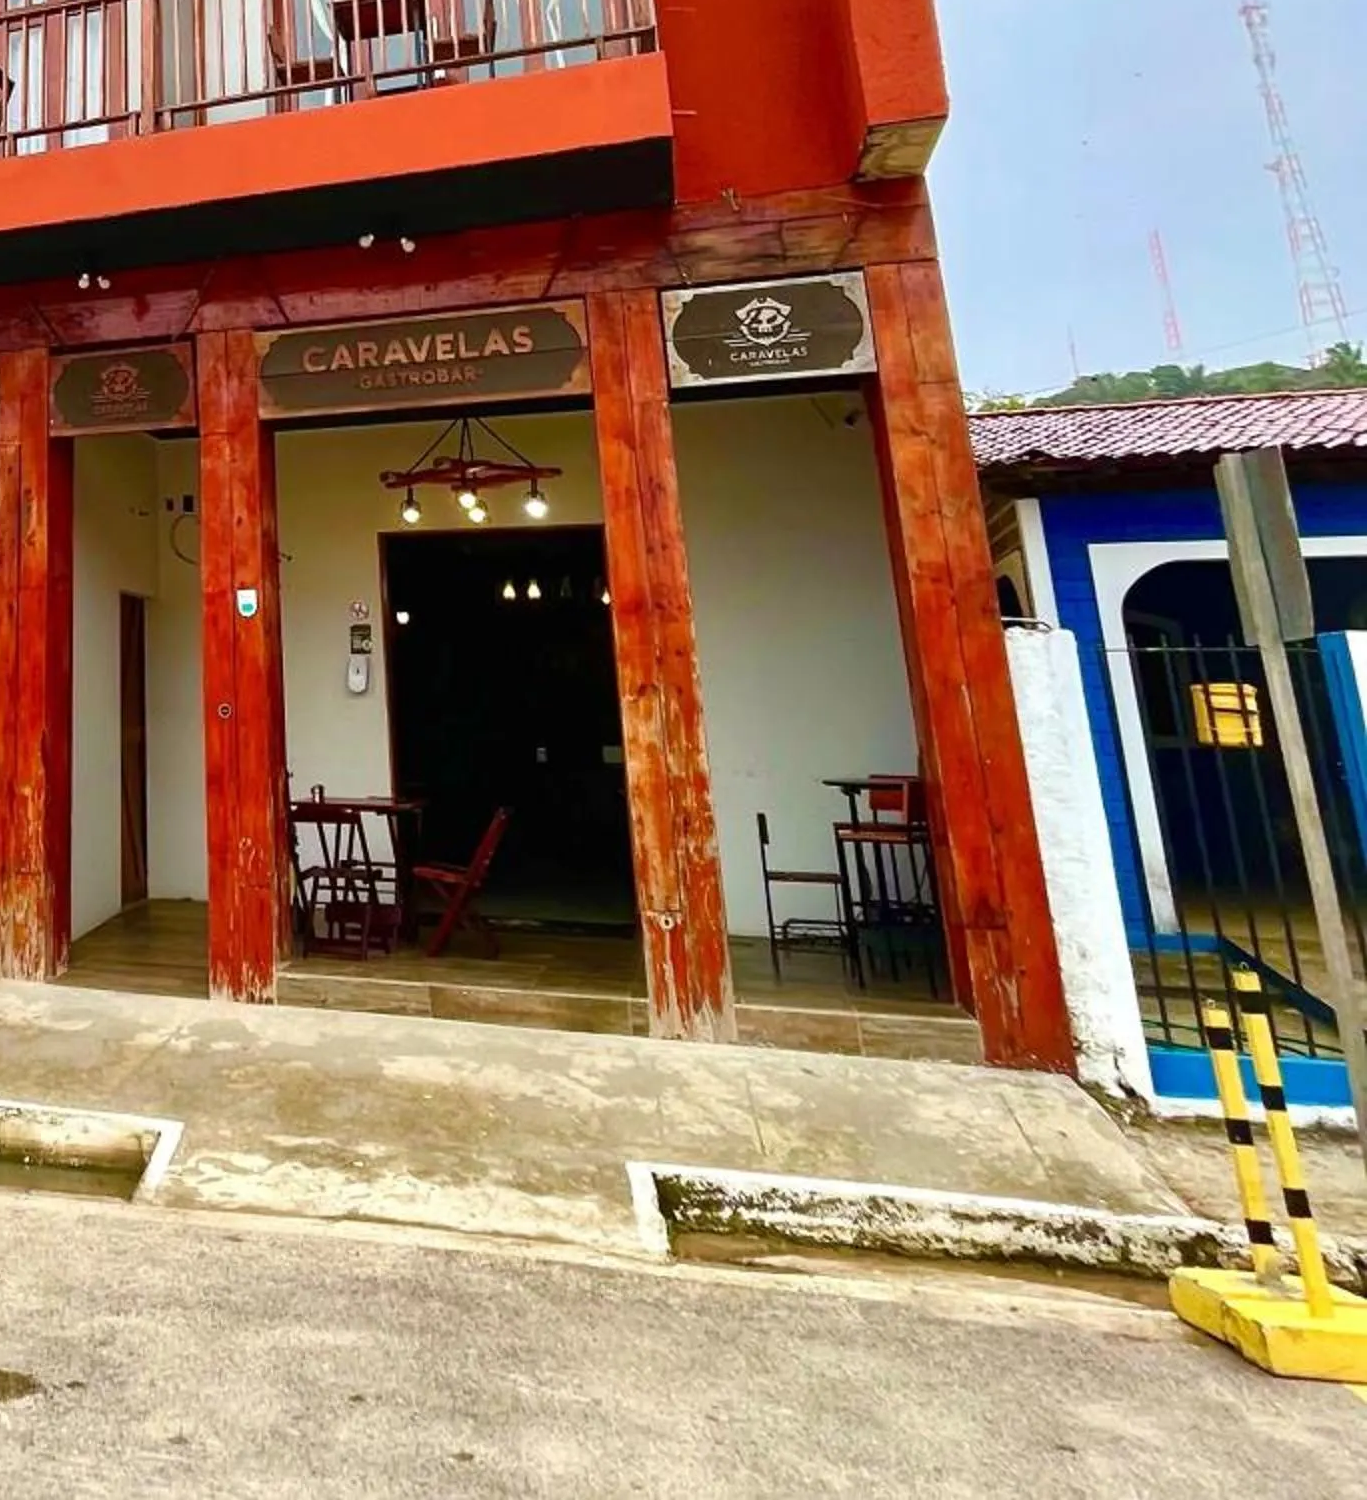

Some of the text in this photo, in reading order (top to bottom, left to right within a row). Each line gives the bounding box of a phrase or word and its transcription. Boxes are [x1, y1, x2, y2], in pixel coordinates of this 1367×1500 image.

[302, 325, 534, 373] CARAVELAS
[730, 346, 808, 361] CARAVELAS
[360, 364, 477, 390] GASTROBAR
